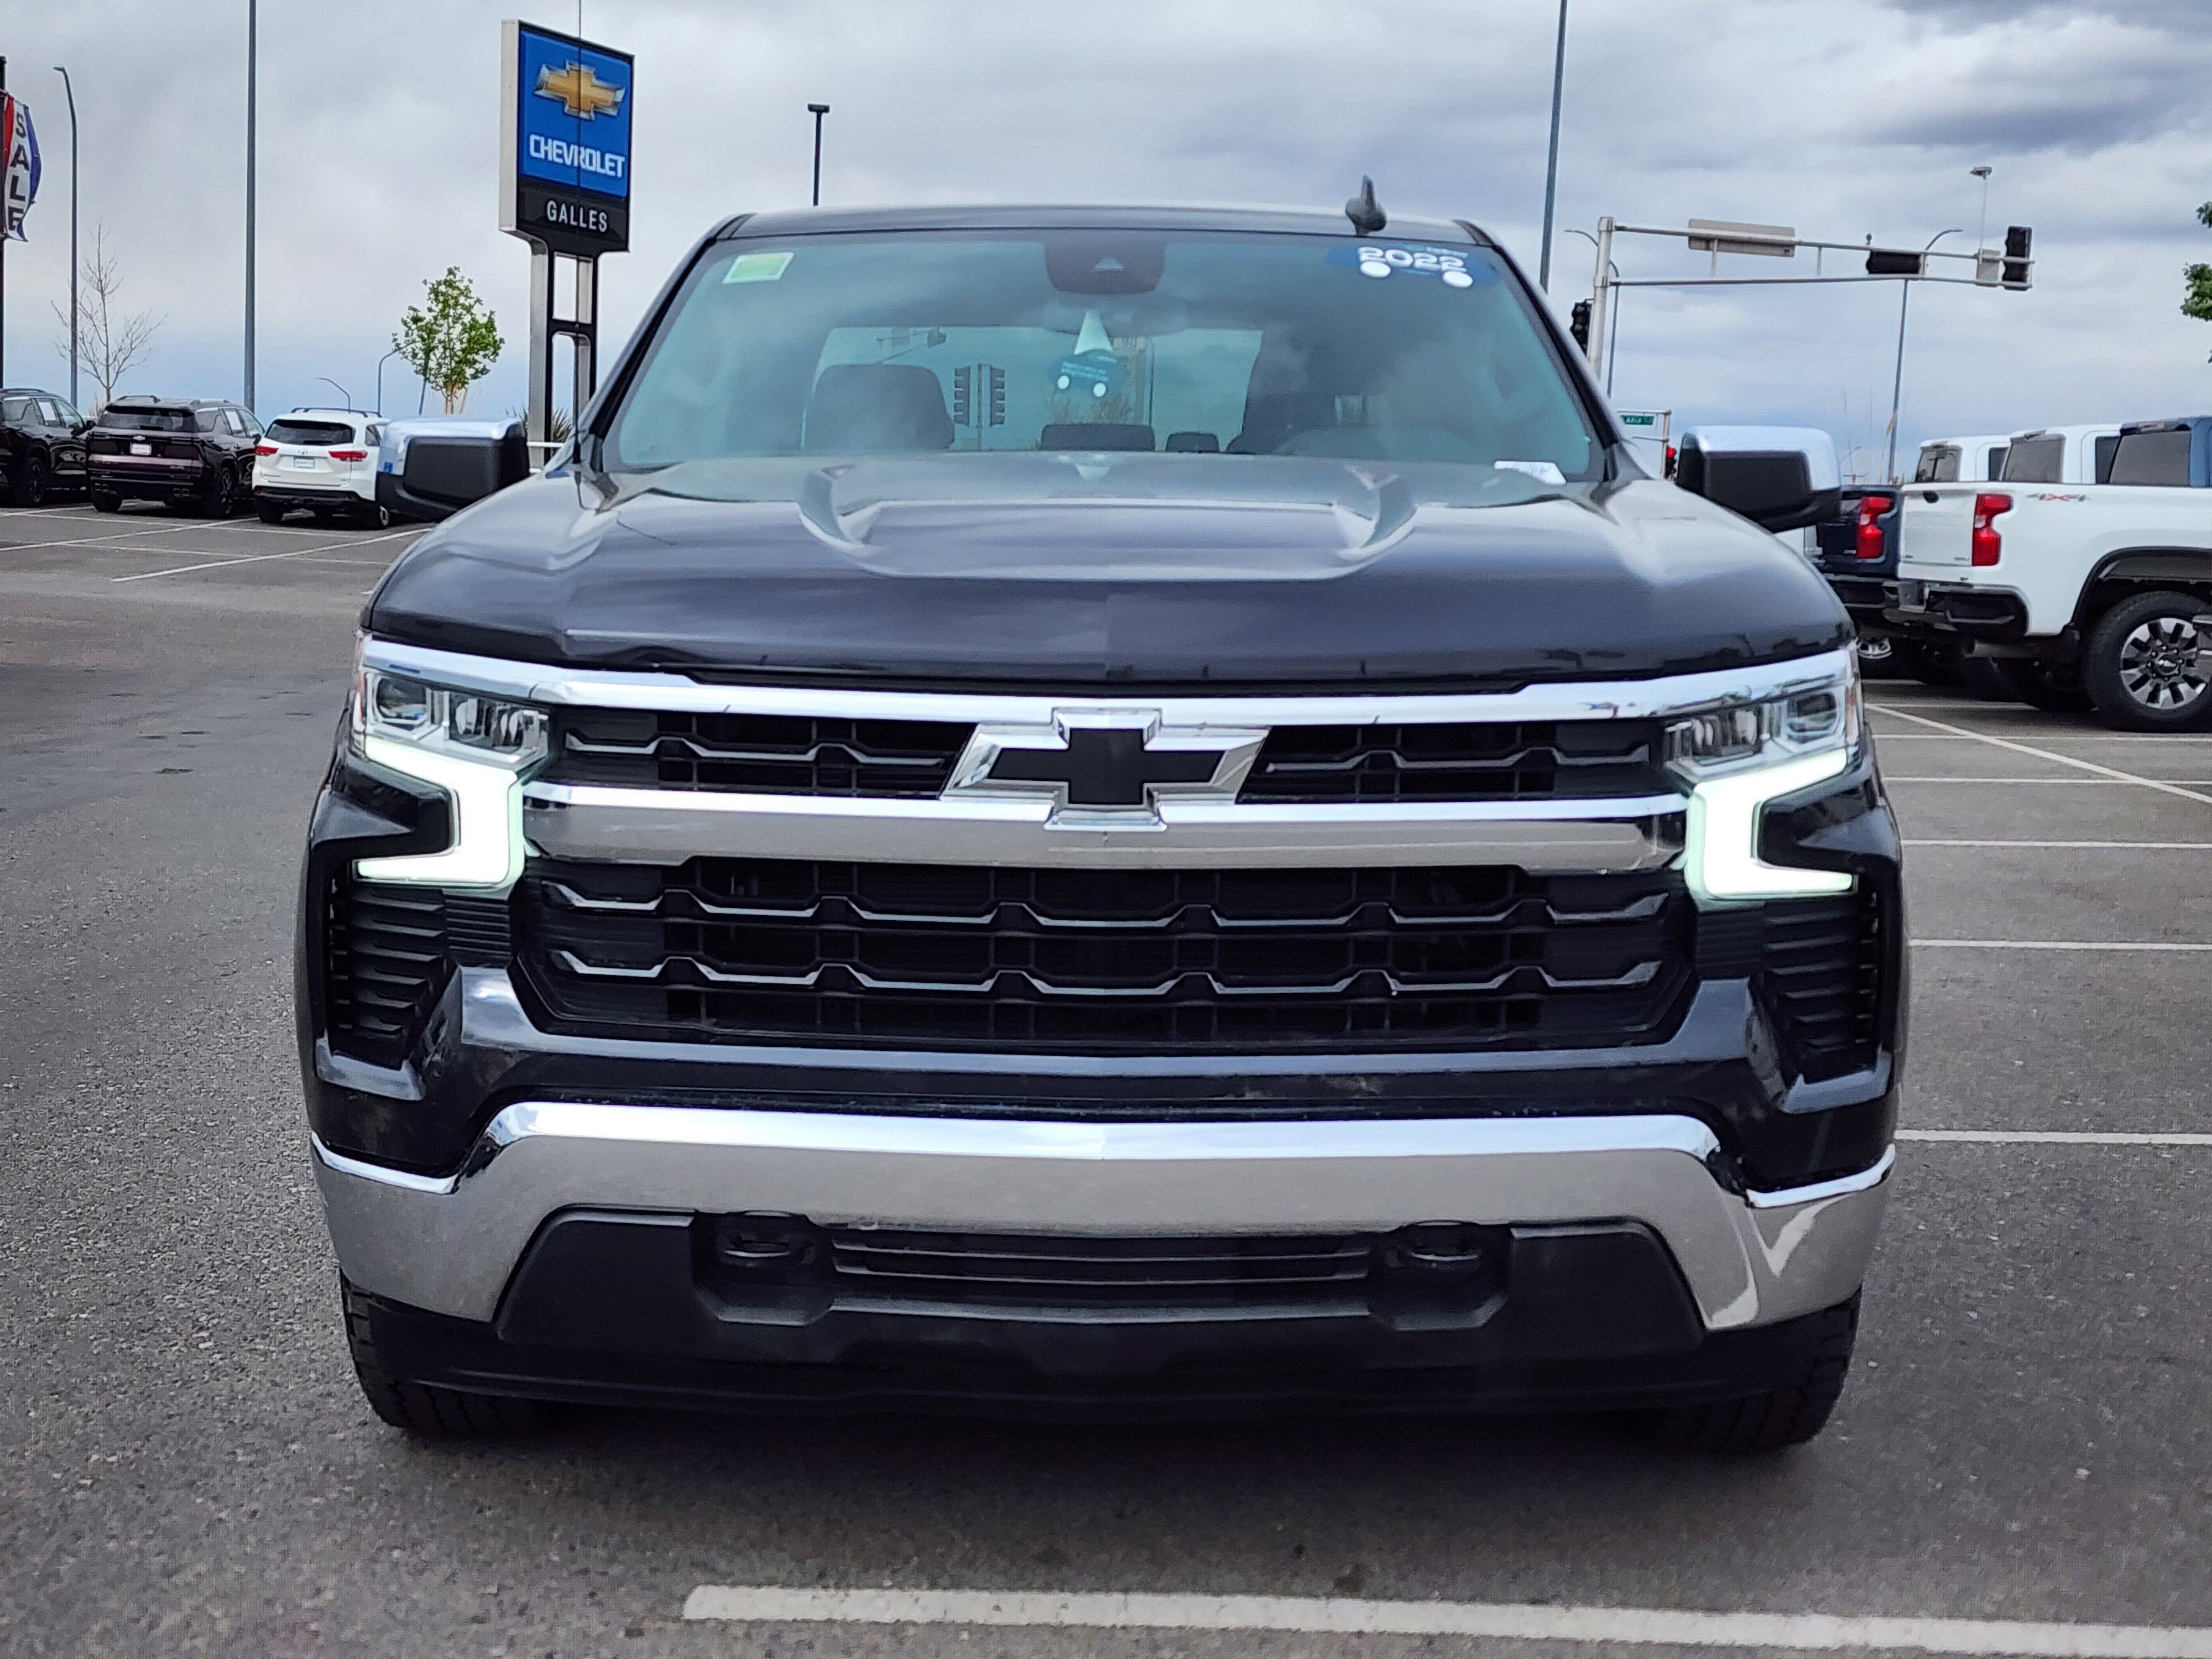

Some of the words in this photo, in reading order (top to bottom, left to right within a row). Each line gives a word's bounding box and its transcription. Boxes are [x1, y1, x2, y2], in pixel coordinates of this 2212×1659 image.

[8, 111, 29, 231] SALE
[529, 134, 625, 178] CHEVROLET
[547, 200, 608, 232] GALLES
[1358, 247, 1467, 272] 2022
